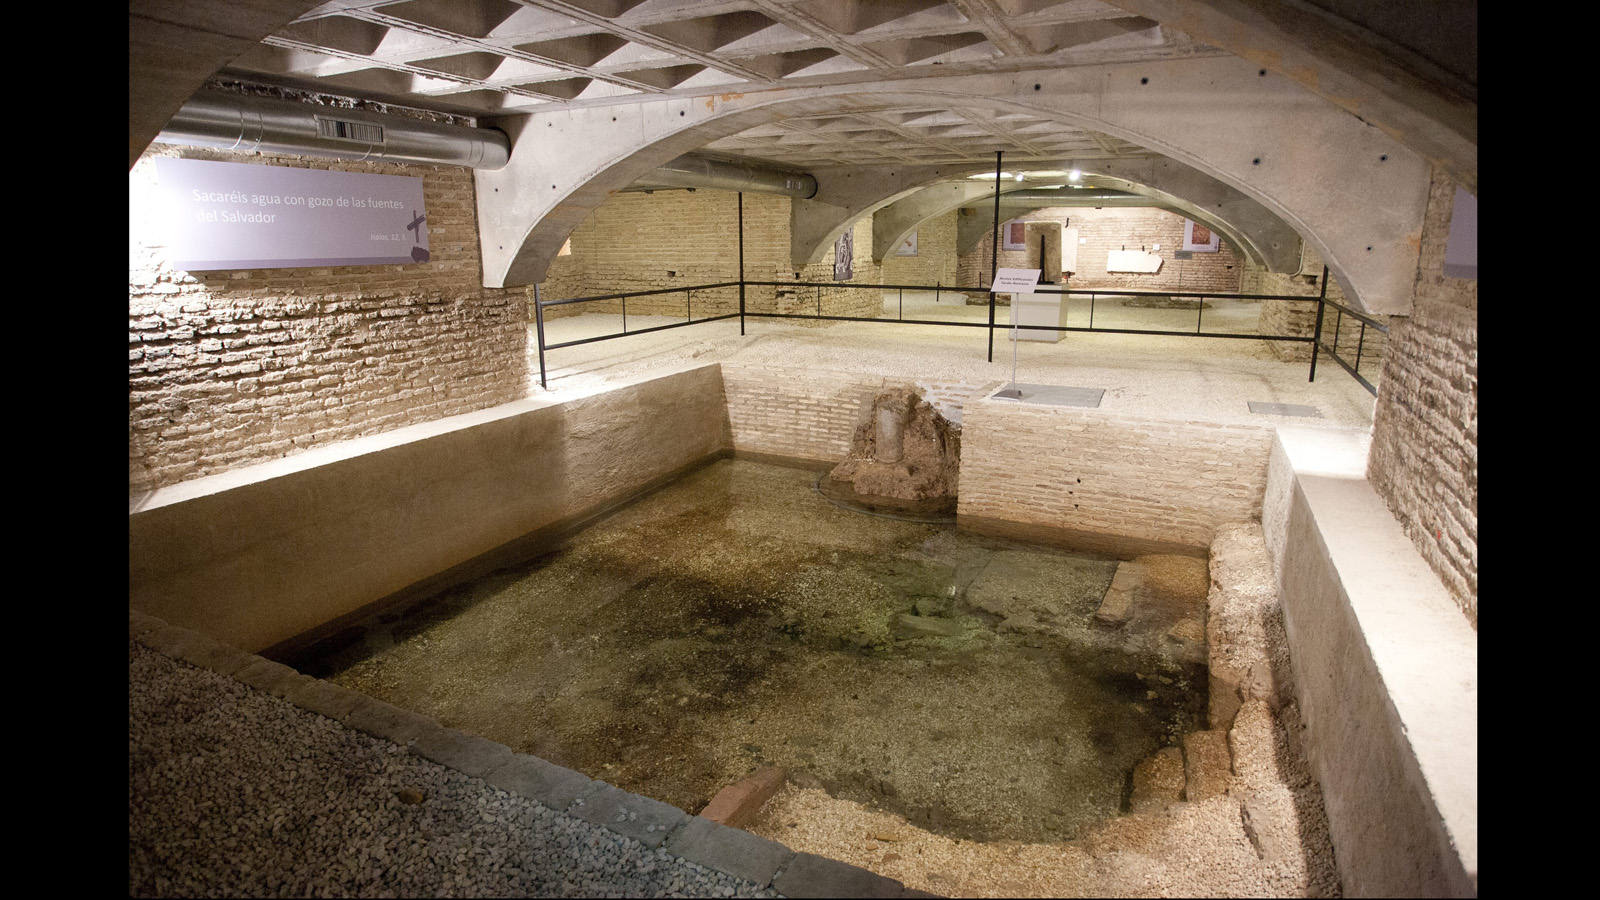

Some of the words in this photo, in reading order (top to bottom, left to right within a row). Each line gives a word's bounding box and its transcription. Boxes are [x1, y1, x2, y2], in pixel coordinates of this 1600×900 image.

[192, 189, 248, 204] Sacaréis
[251, 194, 281, 207] agua
[283, 195, 305, 205] con
[308, 197, 333, 209] gozo
[336, 196, 350, 207] de
[352, 197, 366, 208] las
[368, 197, 404, 209] fuentes
[222, 210, 276, 224] Salvador
